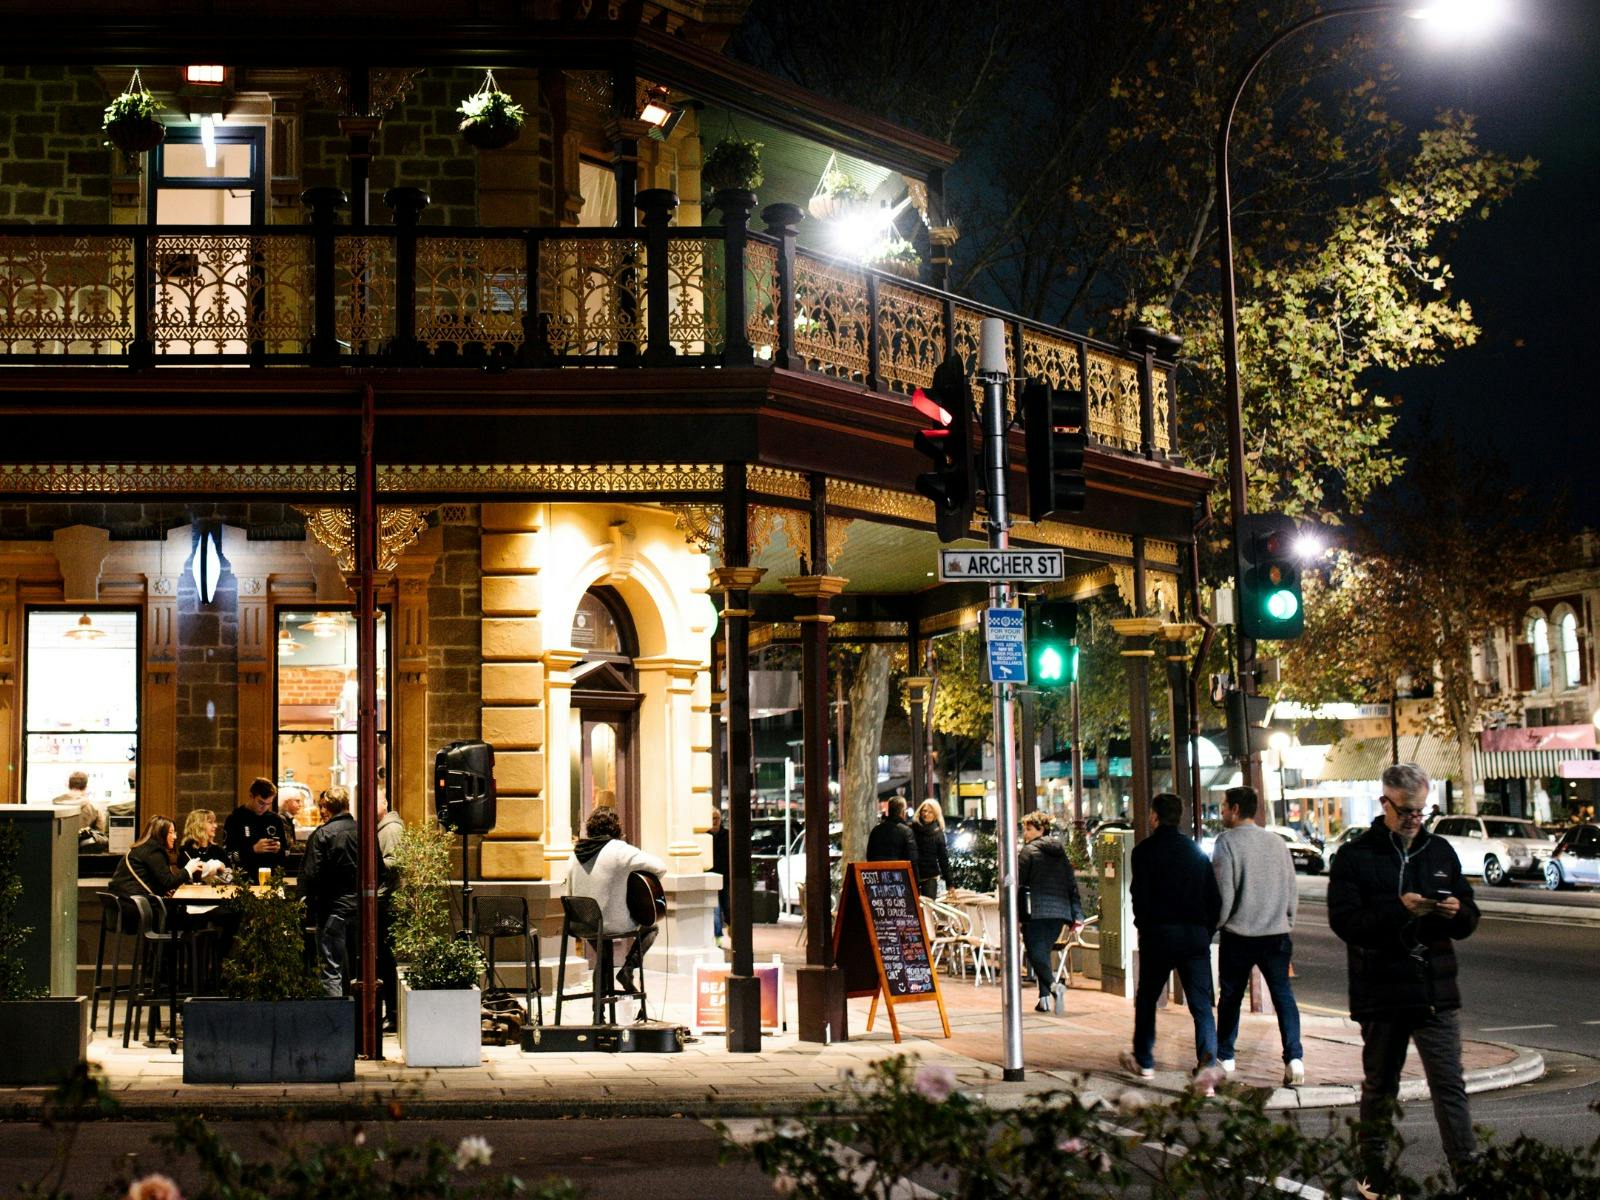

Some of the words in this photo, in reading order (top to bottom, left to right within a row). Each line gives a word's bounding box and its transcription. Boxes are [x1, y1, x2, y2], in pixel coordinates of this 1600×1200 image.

[968, 556, 1033, 574] ARCHER
[1038, 556, 1057, 574] ST
[861, 871, 879, 885] PSST!
[870, 884, 905, 897] THIRSTY?
[871, 899, 884, 907] OVER
[875, 907, 885, 916] TO
